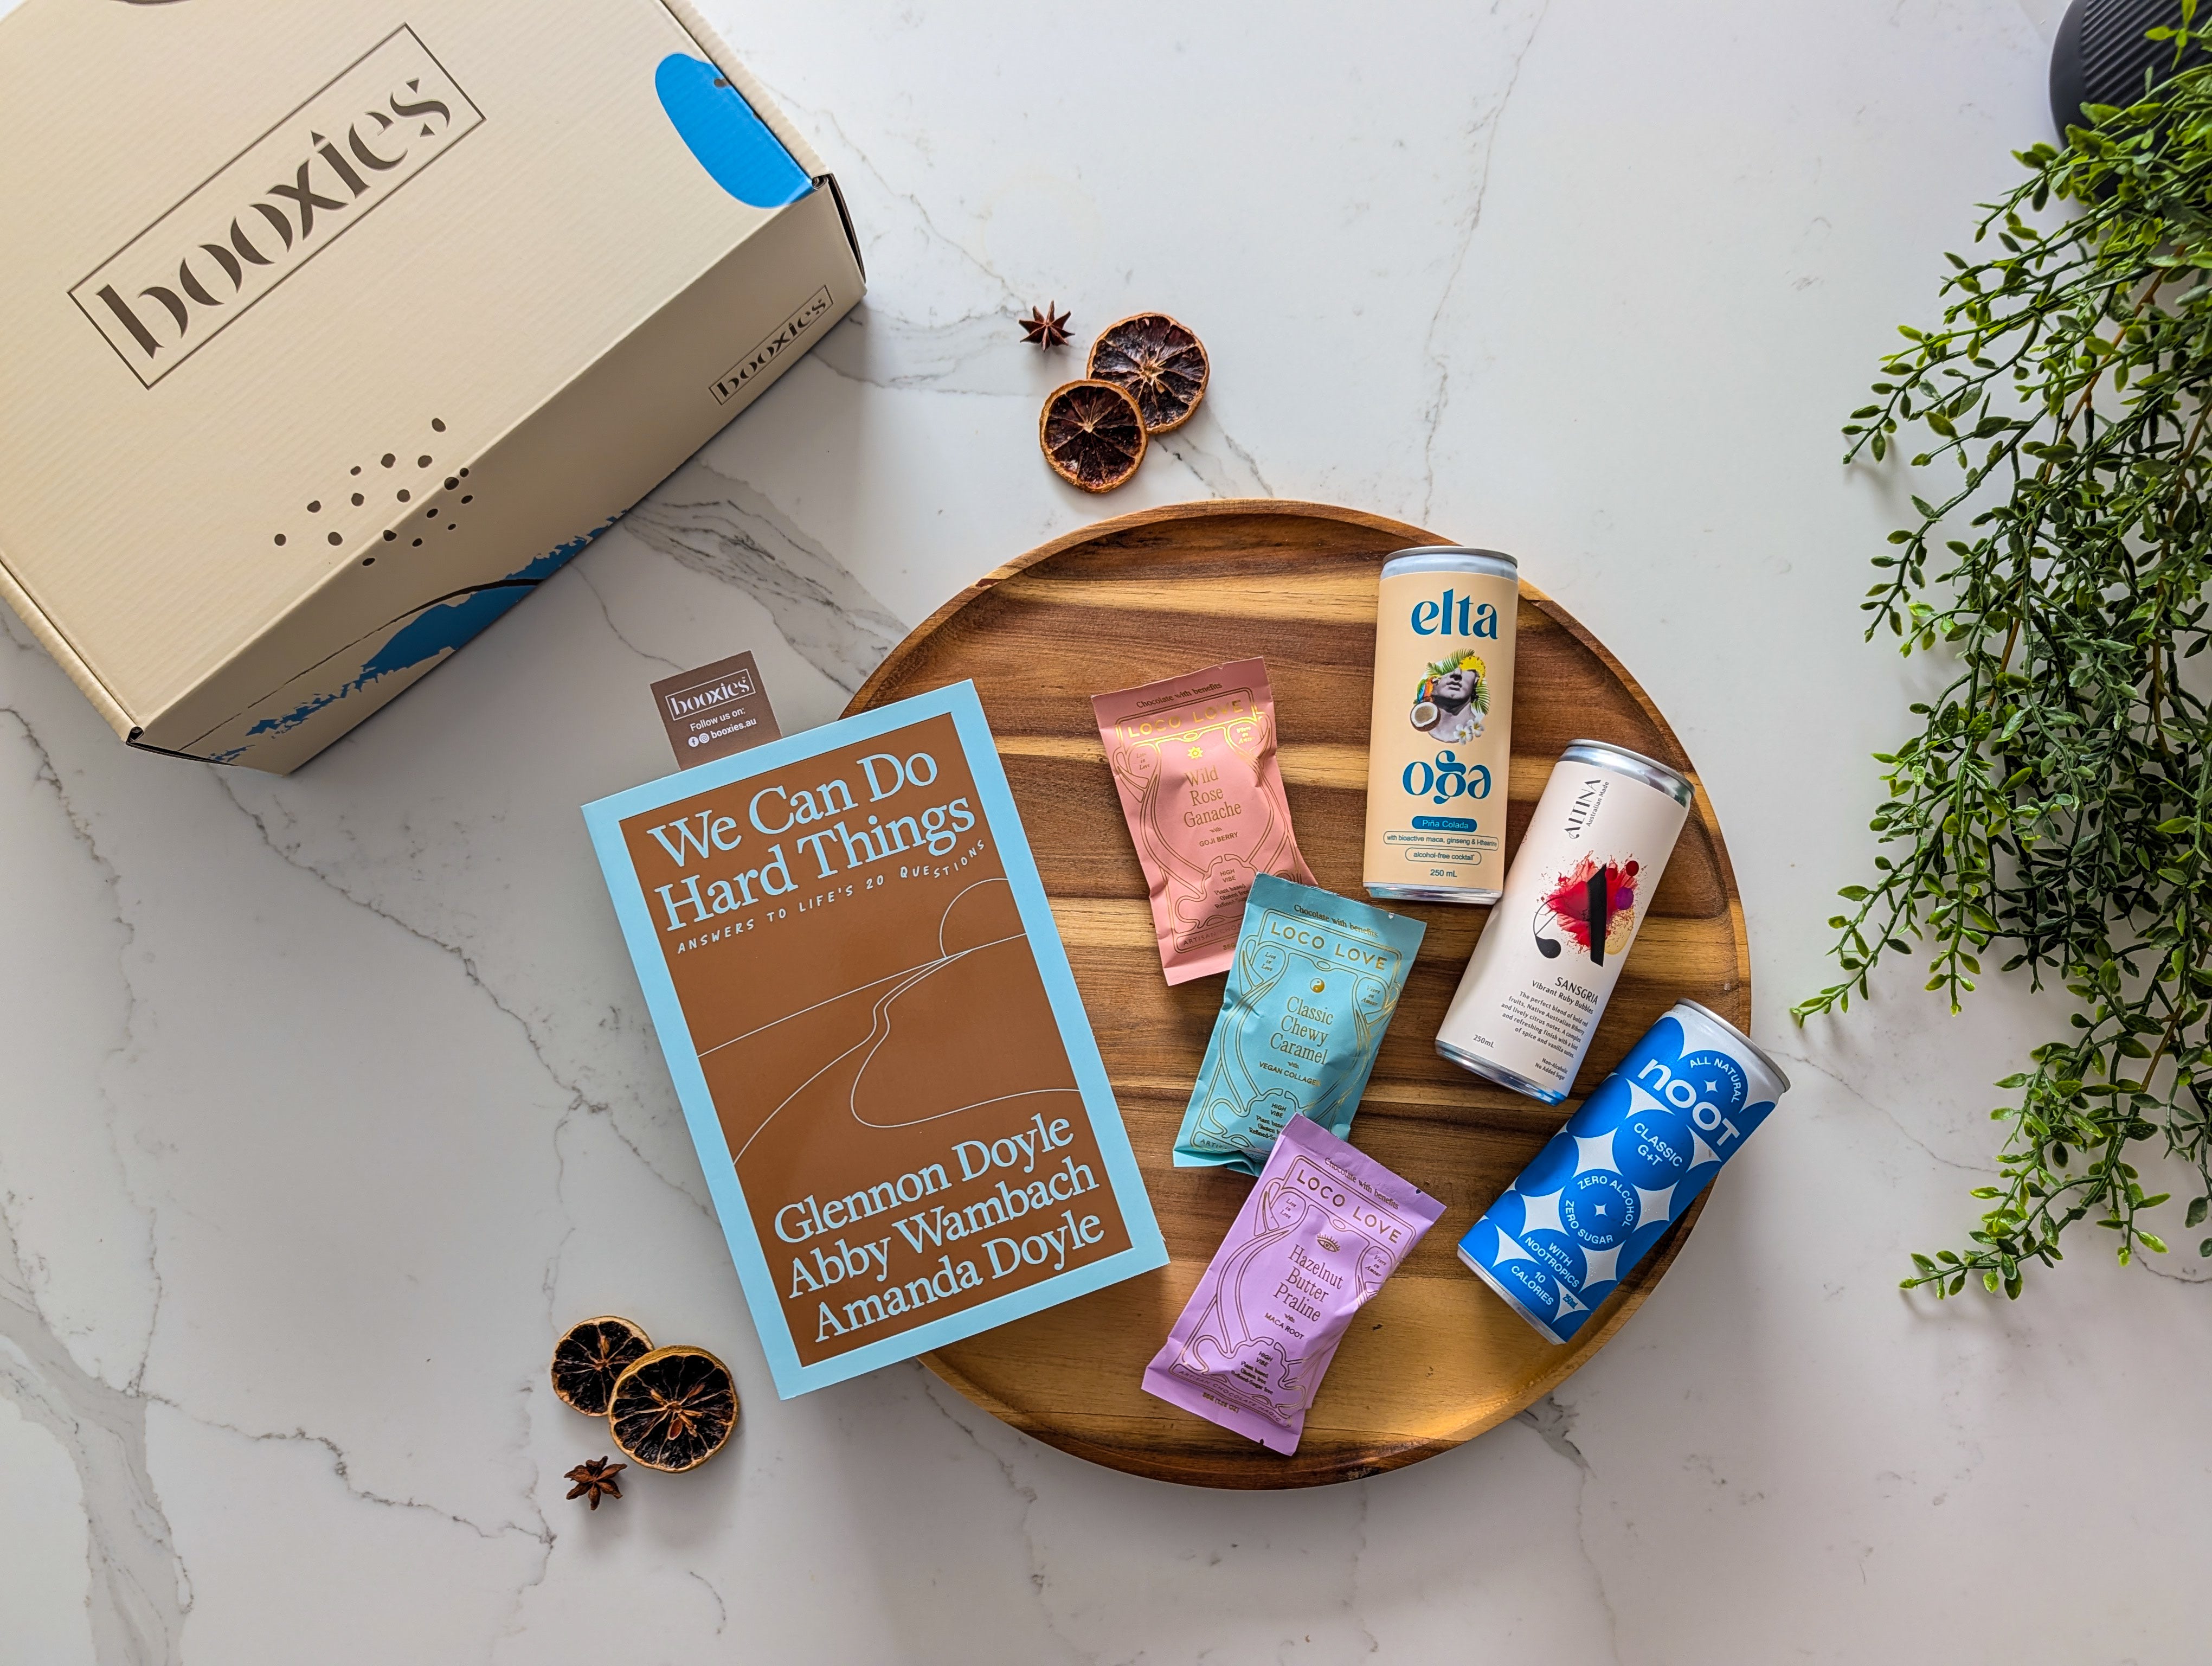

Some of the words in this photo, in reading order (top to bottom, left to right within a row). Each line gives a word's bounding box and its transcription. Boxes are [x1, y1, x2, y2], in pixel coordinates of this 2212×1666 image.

[95, 77, 451, 359] booxies
[717, 299, 826, 398] booxies
[1411, 588, 1499, 639] elta
[670, 676, 749, 715] booxies
[1136, 694, 1174, 709] Chocolate
[1175, 690, 1192, 700] with
[1192, 683, 1223, 696] benefits
[690, 716, 718, 731] Follow
[732, 708, 745, 716] on:
[710, 718, 757, 739] booxies.au
[1128, 716, 1181, 738] LOCO
[1193, 700, 1244, 723] LOVE
[1185, 766, 1219, 787] Wild
[647, 809, 742, 867] We
[749, 778, 859, 835] Can
[856, 753, 938, 802] Do
[1189, 786, 1224, 806] Rose
[1564, 779, 1602, 840] ALTINA
[1586, 798, 1603, 826] Australian
[1600, 781, 1610, 798] Made
[1184, 802, 1242, 828] Ganache
[1442, 821, 1468, 829] Colada
[1199, 838, 1216, 847] GOJI
[1217, 832, 1238, 842] BERRY
[654, 844, 799, 931] Hard
[797, 797, 976, 880] Things
[677, 919, 755, 954] ANSWERS
[767, 909, 787, 922] TO
[799, 885, 854, 912] LIFE'S
[866, 876, 884, 890] 20
[900, 840, 986, 879] QUESTIONS
[1220, 892, 1238, 900] Gluten
[1294, 904, 1329, 921] Chocolate
[1332, 917, 1347, 927] with
[1349, 922, 1378, 939] benefits
[1184, 932, 1216, 946] ARTISAN
[1271, 922, 1324, 949] LOCO
[1335, 944, 1387, 970] LOVE
[1261, 963, 1272, 972] Love
[1265, 951, 1276, 959] Live
[1532, 980, 1558, 997] Vibrant
[1558, 991, 1574, 1005] Ruby
[1574, 1000, 1593, 1014] Bubbles
[1555, 977, 1598, 1005] SANSGRIA
[1287, 996, 1334, 1026] Classic
[1508, 996, 1526, 1008] fruits,
[1527, 1003, 1545, 1015] Native
[1546, 1013, 1571, 1028] Australian
[1520, 991, 1530, 999] The
[1531, 996, 1551, 1009] perfect
[1552, 1005, 1567, 1016] blend
[1573, 1015, 1583, 1024] bold
[1281, 1015, 1329, 1047] Chewy
[1513, 1007, 1528, 1018] lively
[1529, 1014, 1545, 1025] citrus
[1546, 1022, 1561, 1032] notes.
[1566, 1031, 1581, 1042] complex
[1514, 1018, 1542, 1034] refreshing
[1543, 1029, 1558, 1040] finish
[1558, 1036, 1567, 1045] with
[1270, 1032, 1328, 1065] Caramel
[1473, 1034, 1495, 1048] 250mL
[1522, 1030, 1536, 1039] spice
[1548, 1042, 1564, 1053] vanilla
[1564, 1050, 1574, 1058] notes.
[1259, 1061, 1282, 1075] VEGAN
[1287, 1060, 1299, 1069] with
[1542, 1058, 1568, 1074] Non-Alcoholic
[1542, 1066, 1556, 1075] Added
[1555, 1072, 1565, 1080] Sugar
[1690, 1056, 1711, 1068] ALL
[1714, 1058, 1741, 1103] NATURAL
[1256, 1115, 1270, 1125] Plant
[1270, 1110, 1284, 1118] VIBE
[1271, 1103, 1287, 1112] HIGH
[1258, 1123, 1275, 1133] Gluten
[1634, 1123, 1683, 1167] CLASSIC
[1637, 1144, 1663, 1167] G+T
[774, 1163, 952, 1243] Glennon
[951, 1113, 1074, 1181] Doyle
[1324, 1157, 1356, 1183] Chocolate
[1358, 1180, 1373, 1194] with
[1374, 1191, 1400, 1210] benefits
[1279, 1209, 1291, 1219] Love
[1286, 1198, 1297, 1208] Live
[1296, 1169, 1346, 1207] LOCO
[1353, 1206, 1402, 1244] LOVE
[1577, 1176, 1607, 1190] ZERO
[1609, 1180, 1635, 1227] ALCOHOL
[789, 1237, 891, 1298] Abby
[892, 1156, 1100, 1254] Wambach
[1565, 1200, 1579, 1229] ZERO
[1577, 1228, 1613, 1244] SUGAR
[1288, 1244, 1343, 1290] Hazelnut
[1525, 1236, 1580, 1288] NOOTROPICS
[1548, 1242, 1572, 1266] WITH
[815, 1255, 983, 1343] Amanda
[982, 1210, 1105, 1279] Doyle
[1285, 1266, 1329, 1303] Butter
[1365, 1265, 1382, 1277] Amour
[1511, 1265, 1554, 1306] CALORIES
[1535, 1272, 1546, 1283] 10
[1273, 1282, 1321, 1322] Praline
[1264, 1312, 1284, 1329] MACA
[1284, 1325, 1304, 1340] ROOT
[1284, 1313, 1295, 1323] with
[1256, 1357, 1269, 1367] VIBE
[1258, 1351, 1274, 1361] HIGH
[1179, 1370, 1211, 1385] ARTISAN
[1213, 1383, 1257, 1407] CHOCOLATE
[1258, 1406, 1282, 1422] MAGIC
